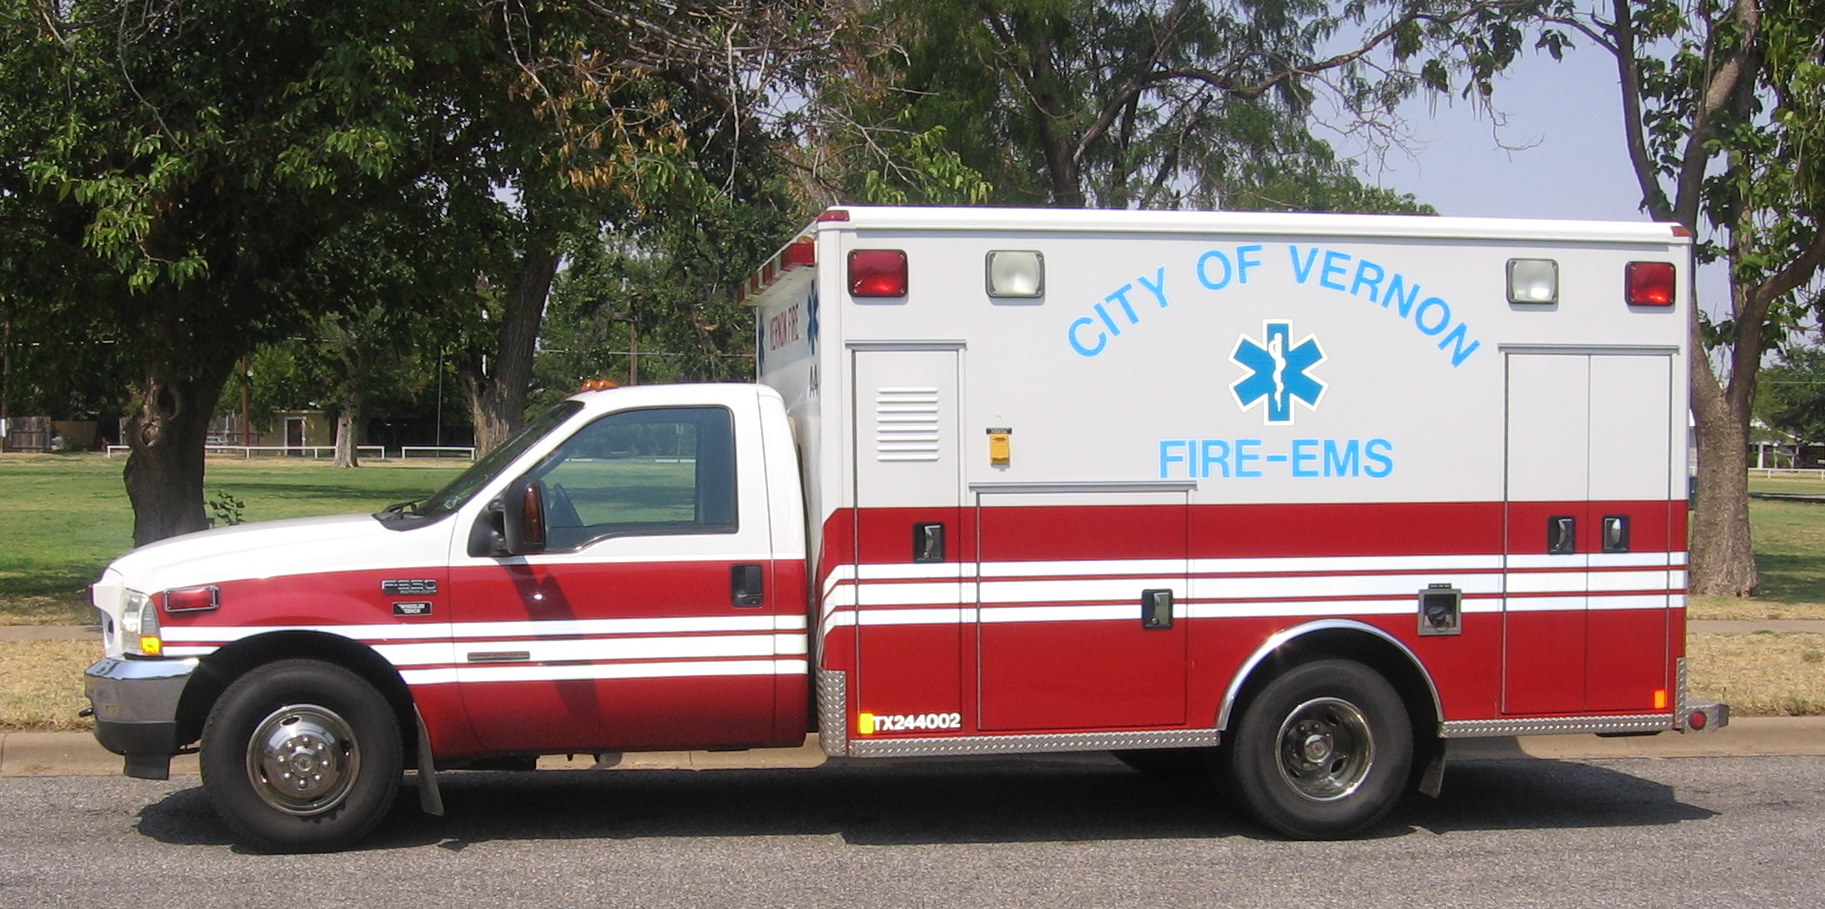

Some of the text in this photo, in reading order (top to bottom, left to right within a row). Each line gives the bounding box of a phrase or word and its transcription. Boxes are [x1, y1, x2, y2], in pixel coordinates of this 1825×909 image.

[1067, 244, 1481, 369] CITY OF VERNON
[1159, 437, 1394, 479] FIRE-EMS
[872, 712, 961, 731] TX244002
